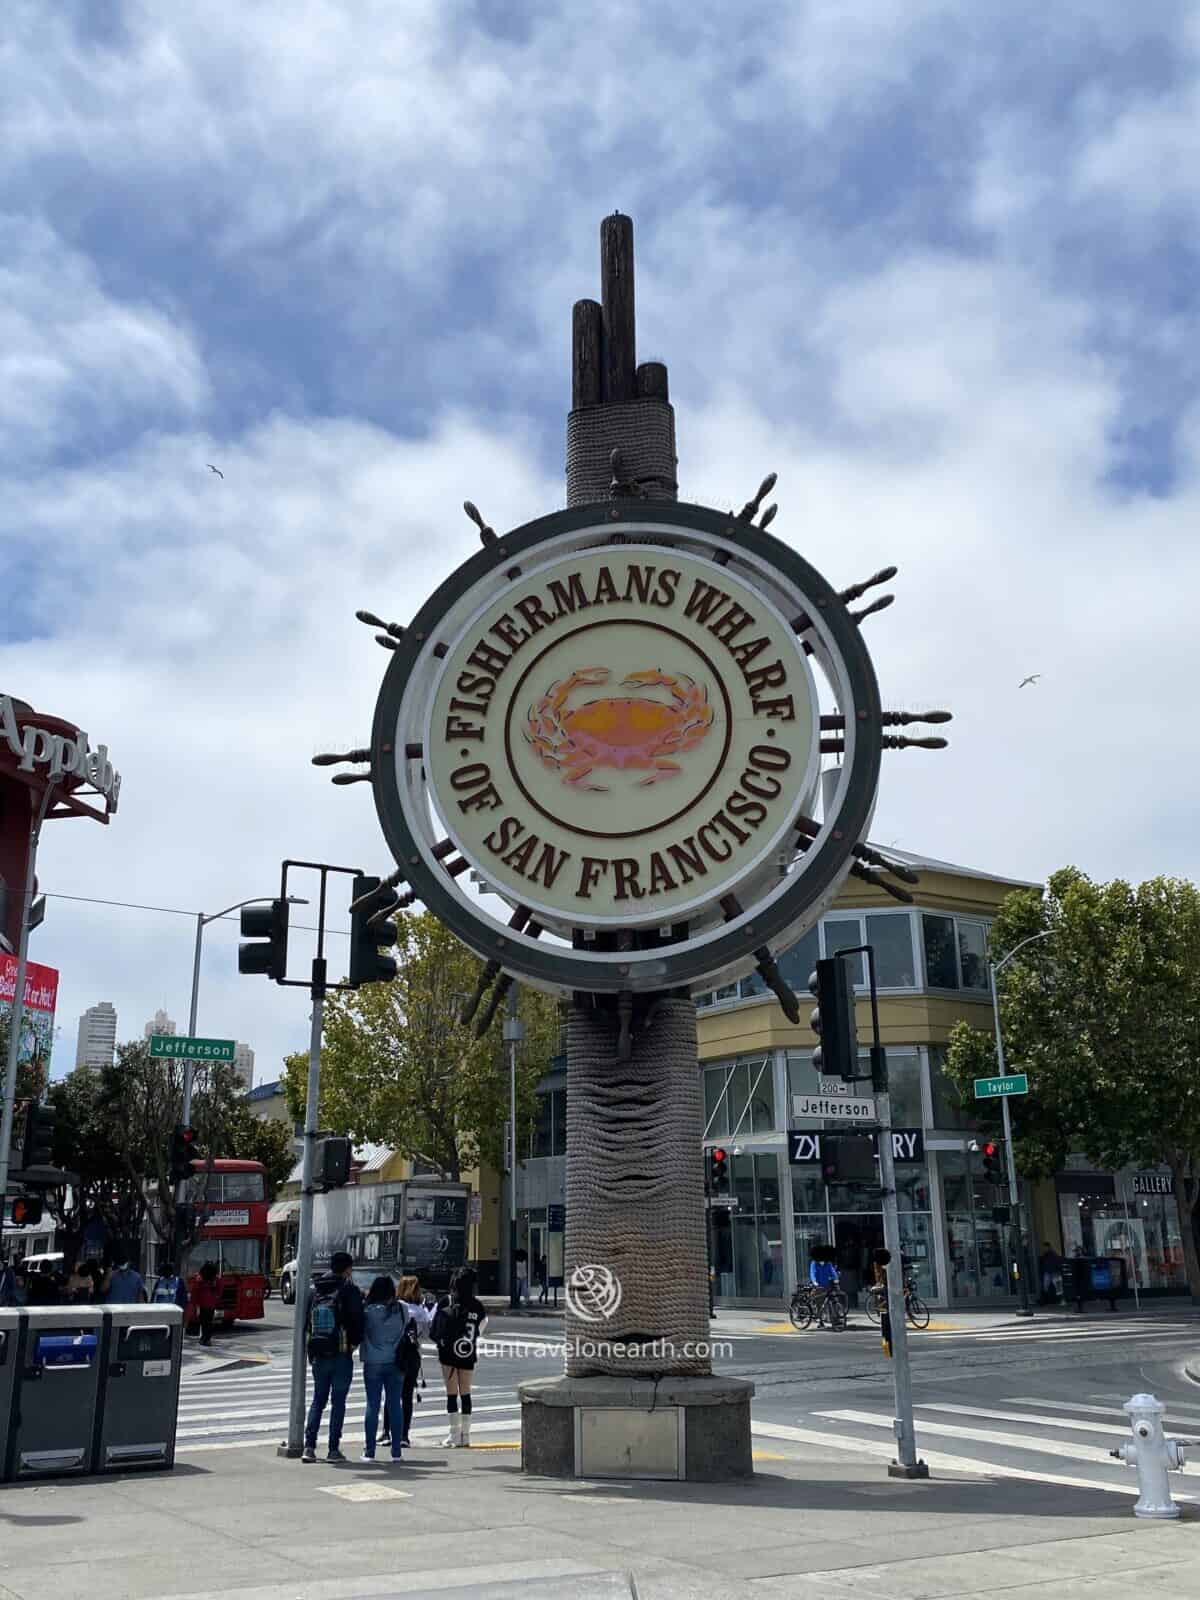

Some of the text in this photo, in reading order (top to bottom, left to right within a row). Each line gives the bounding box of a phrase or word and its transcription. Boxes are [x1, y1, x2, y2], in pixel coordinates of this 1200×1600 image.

[446, 564, 796, 743] FISHERMANS WHARF
[450, 745, 792, 901] OF SAN FRANCISCO
[155, 1040, 230, 1056] Jefferson
[822, 1083, 838, 1094] 200
[987, 1082, 1015, 1093] Taylor
[801, 1099, 869, 1116] Jefferson
[1132, 1176, 1172, 1193] GALLERY
